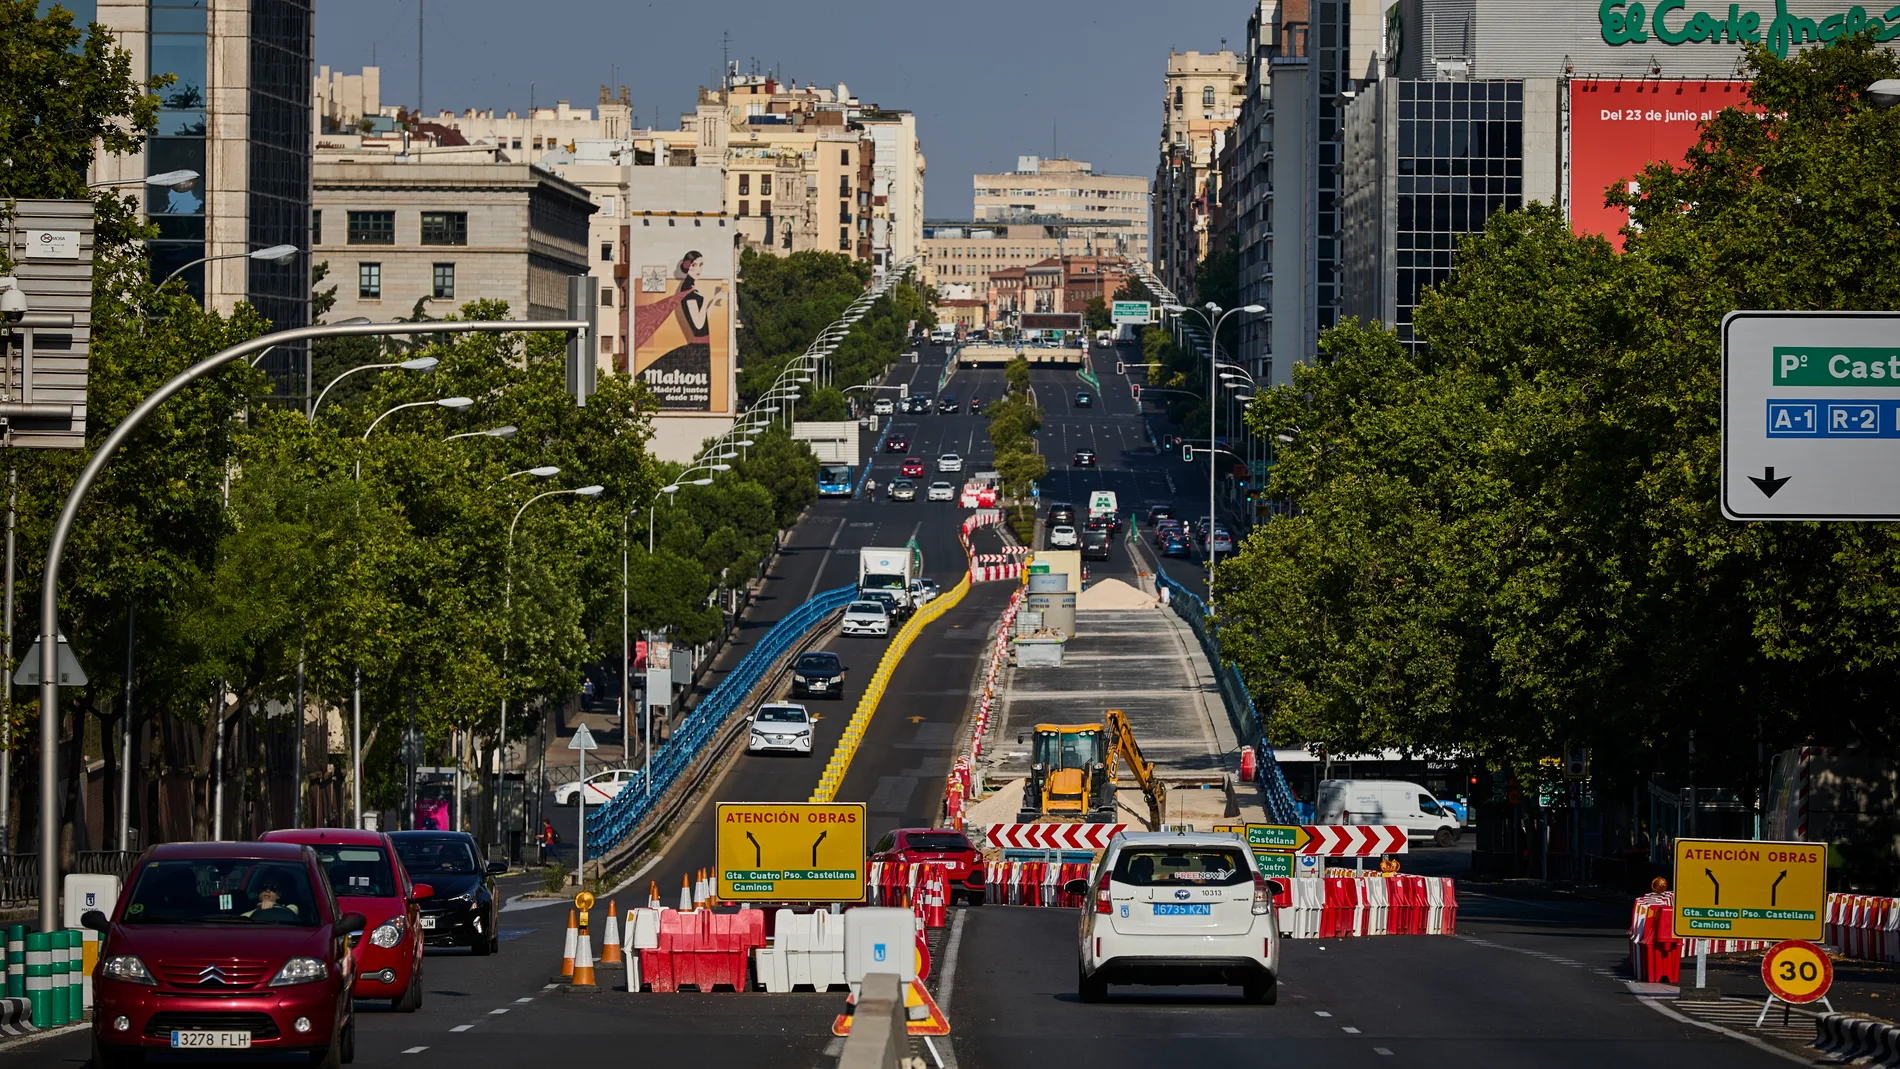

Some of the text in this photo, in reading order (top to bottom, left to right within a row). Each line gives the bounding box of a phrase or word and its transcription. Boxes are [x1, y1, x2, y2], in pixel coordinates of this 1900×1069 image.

[1599, 0, 1648, 45] El
[1652, 0, 1761, 44] Corte
[1600, 109, 1622, 121] Del
[1625, 109, 1642, 121] 23
[1645, 109, 1662, 121] de
[1664, 109, 1698, 123] junio
[1700, 110, 1712, 121] al
[1828, 354, 1900, 379] Cast
[644, 369, 708, 385] Mahou
[653, 385, 682, 393] Madrid
[682, 385, 708, 394] juntos
[689, 394, 708, 402] 1890
[1774, 409, 1813, 429] A-1
[1833, 409, 1875, 429] R-2
[726, 811, 857, 823] ATENCIÓN OBRAS
[1249, 835, 1295, 845] Castellana
[1685, 848, 1817, 864] ATENCIÓN OBRAS
[726, 871, 781, 880] Gta. Cuatro
[784, 871, 856, 879] Pso. Castellana
[733, 883, 773, 891] Caminos
[1202, 889, 1223, 897] 10313
[1160, 904, 1210, 914] 6735 KZN
[1683, 909, 1739, 918] Gta. Cuatro
[1742, 910, 1815, 920] Pso. Castellana
[1690, 920, 1731, 929] Caminos
[1779, 961, 1818, 982] 30
[181, 1033, 215, 1046] 3278
[221, 1033, 247, 1046] FLH
